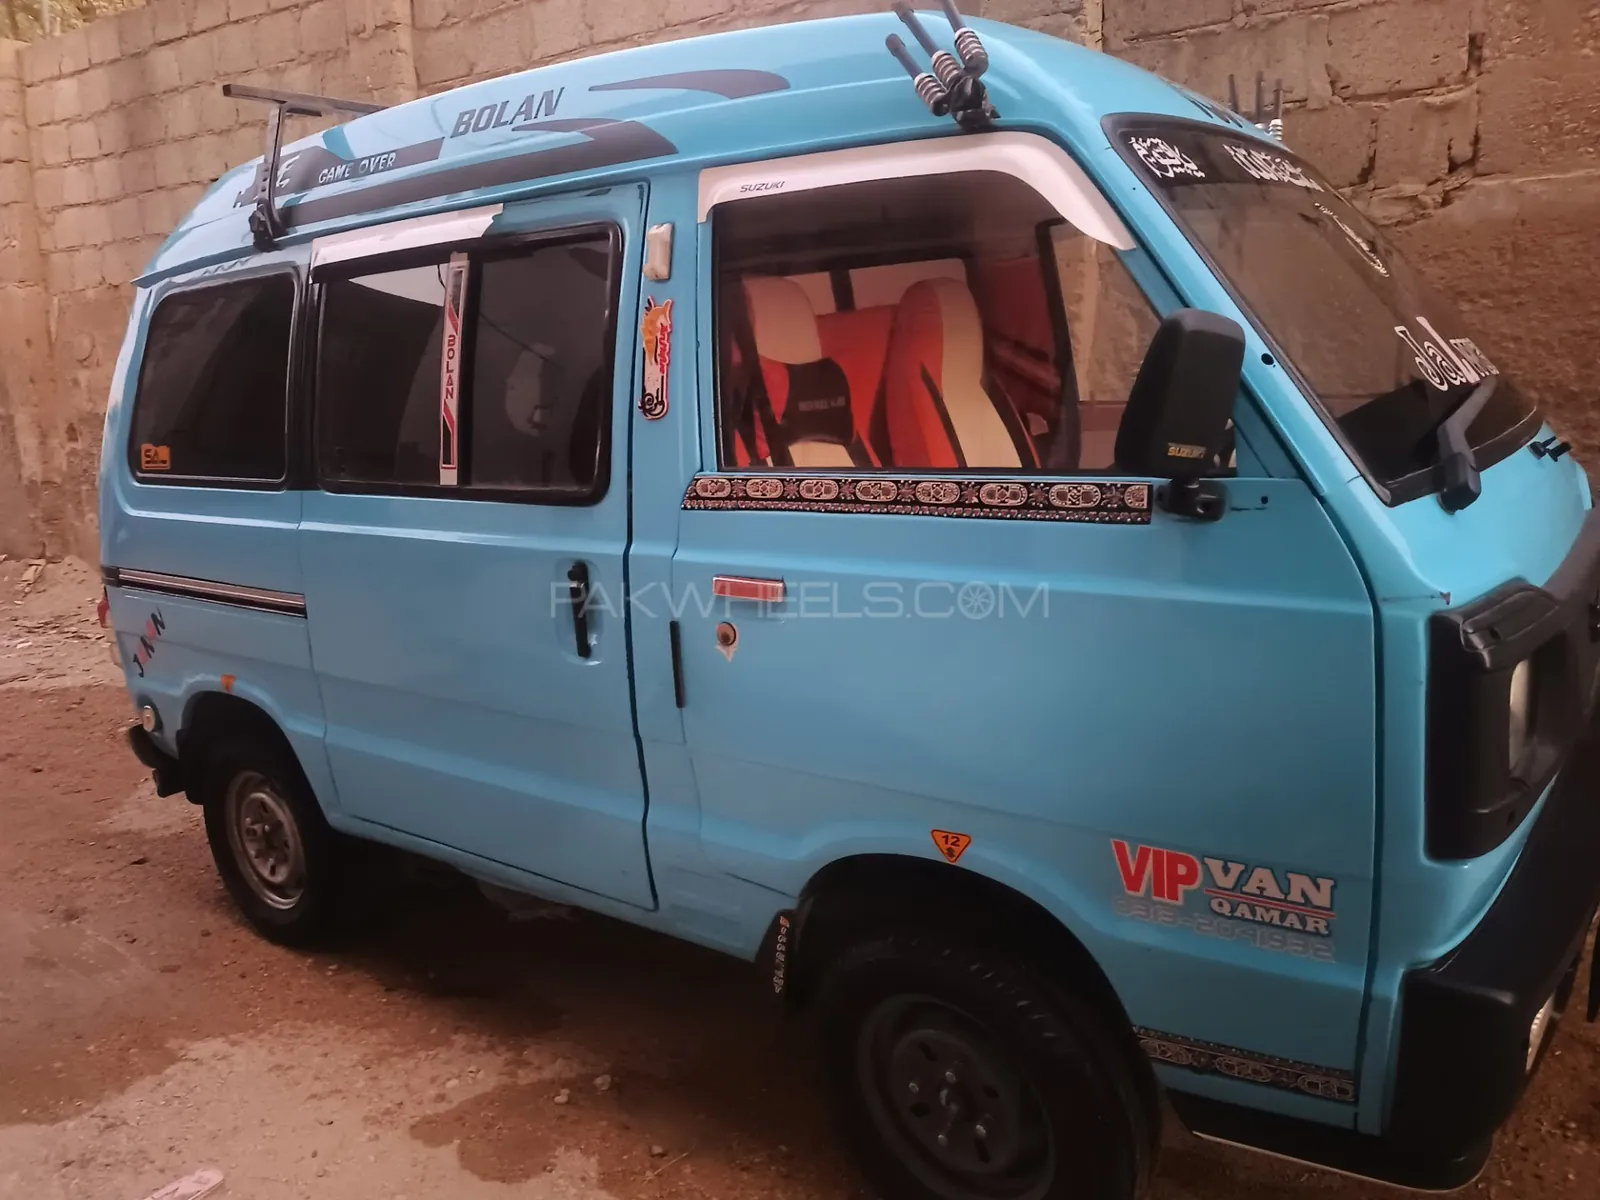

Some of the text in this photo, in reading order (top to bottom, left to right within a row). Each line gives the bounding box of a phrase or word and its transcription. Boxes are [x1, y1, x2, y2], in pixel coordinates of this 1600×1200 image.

[449, 86, 566, 139] BOLAN
[318, 163, 353, 185] GAME
[358, 151, 398, 175] OVER
[740, 180, 786, 193] SUZUKI
[446, 334, 457, 400] BOLAN
[941, 834, 961, 847] 12
[1110, 838, 1335, 909] VIP VAN
[1209, 896, 1330, 936] QAMAR
